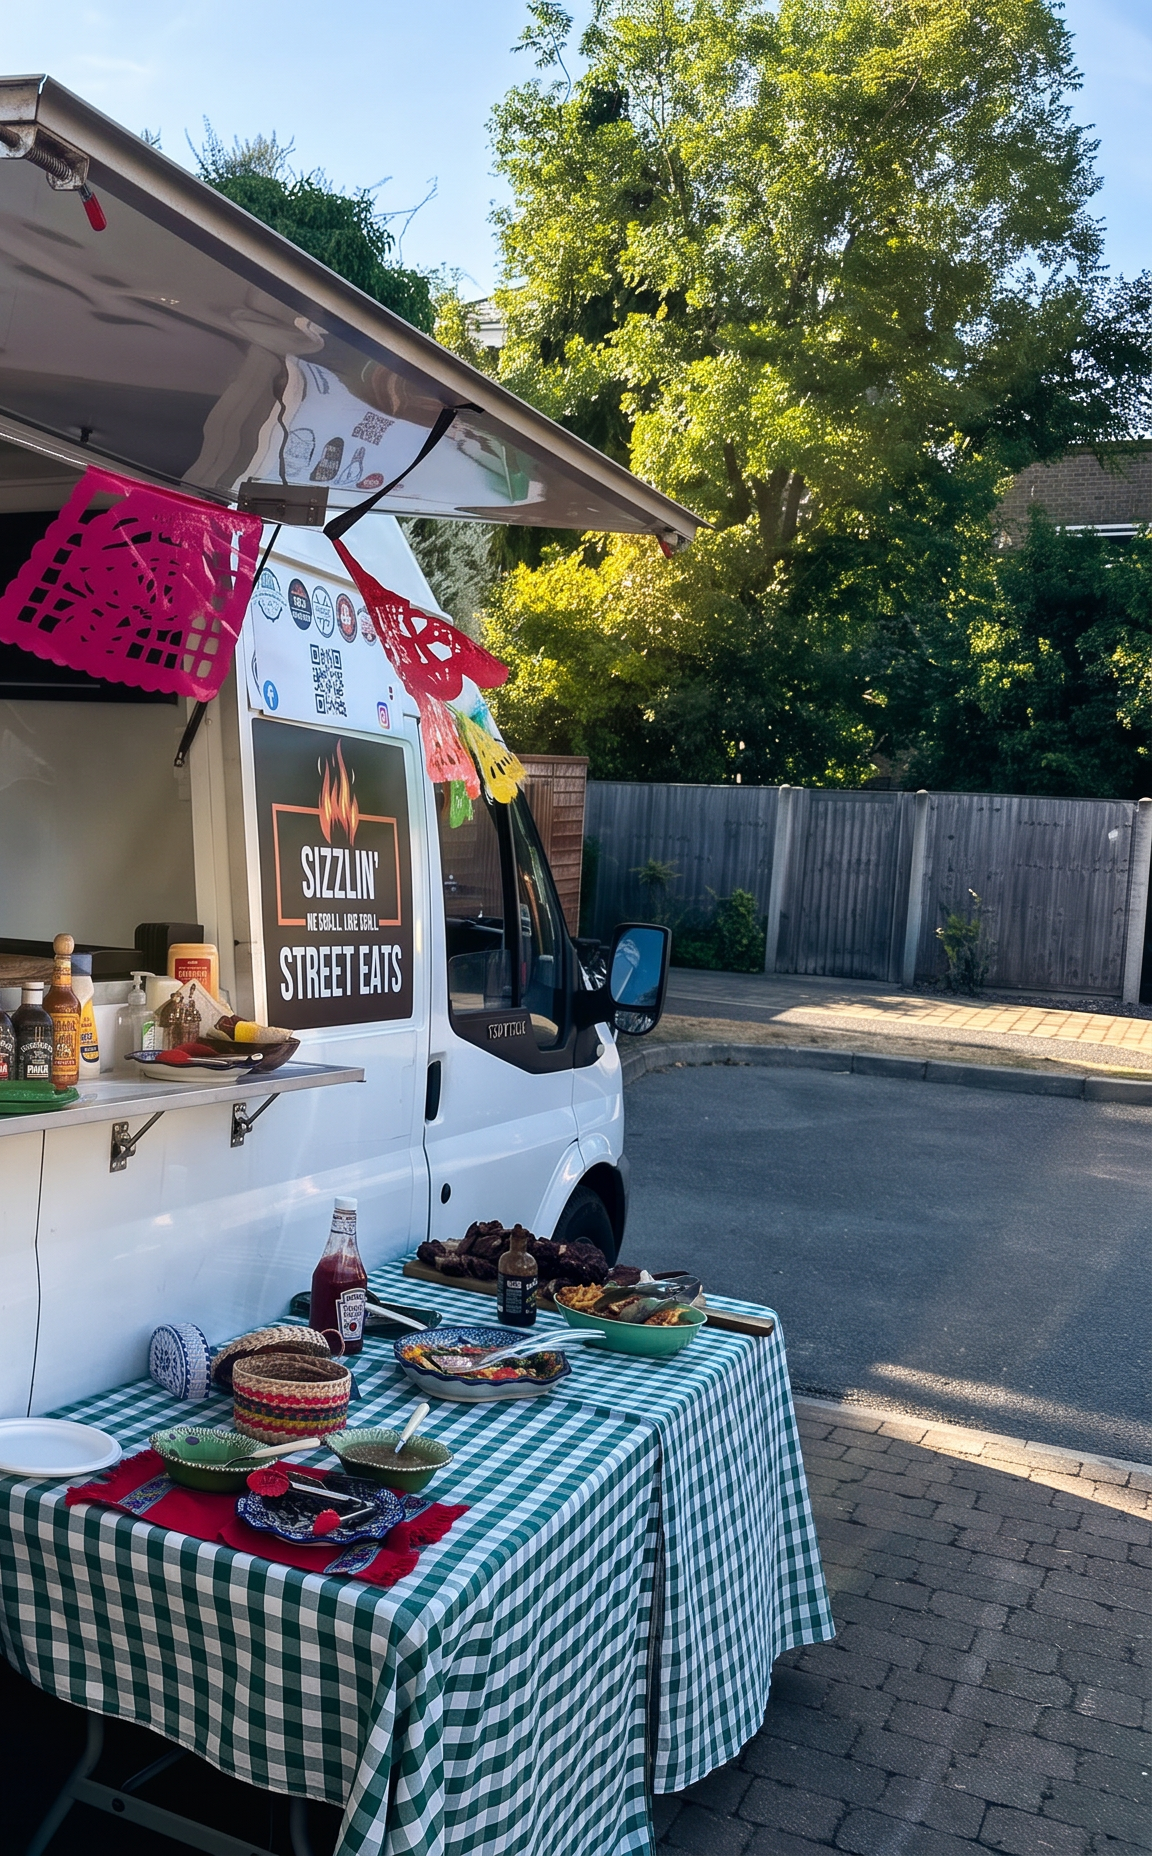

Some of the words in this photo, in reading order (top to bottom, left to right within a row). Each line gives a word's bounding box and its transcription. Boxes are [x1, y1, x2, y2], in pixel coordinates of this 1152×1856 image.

[300, 845, 380, 900] SIZZLIN'
[279, 944, 355, 1002] STREET
[358, 943, 403, 996] EATS
